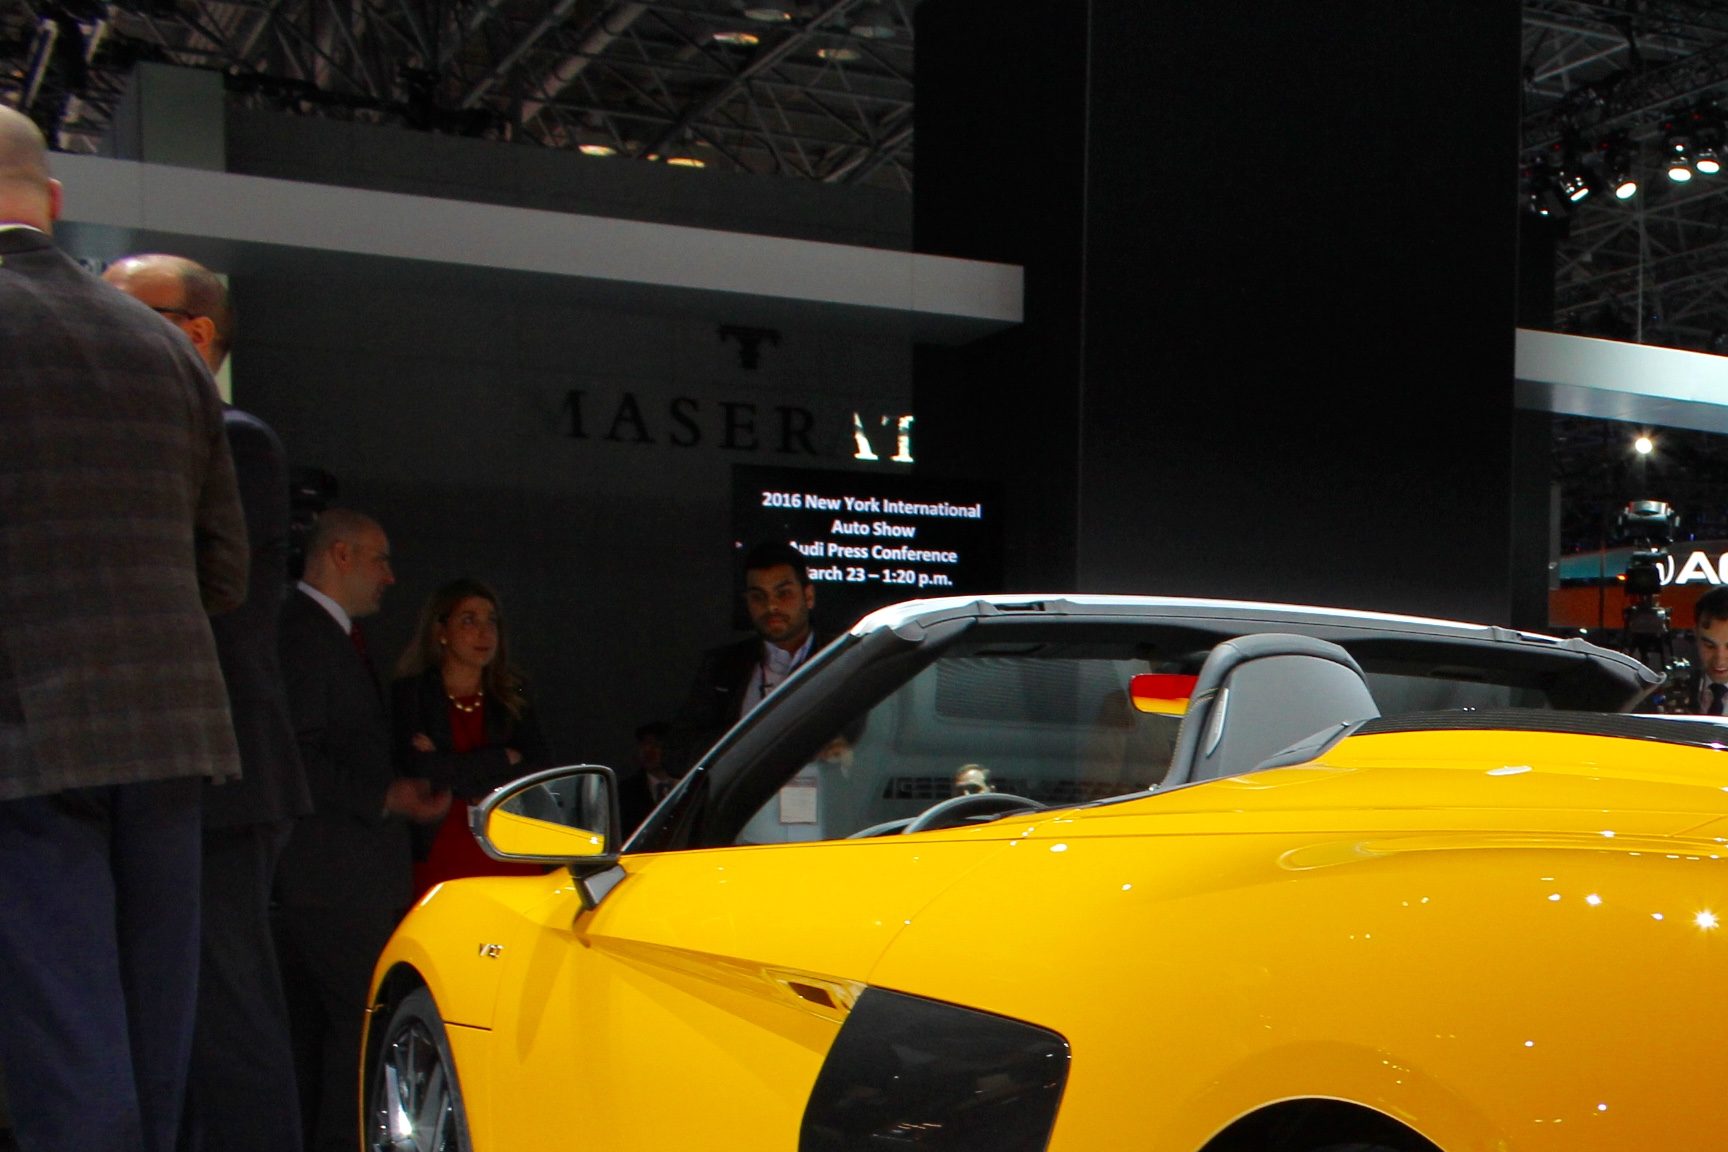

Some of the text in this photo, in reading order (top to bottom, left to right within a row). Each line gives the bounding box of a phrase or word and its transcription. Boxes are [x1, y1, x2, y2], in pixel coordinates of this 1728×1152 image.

[761, 491, 982, 519] 2016 New York International
[830, 519, 916, 538] Auto Show
[827, 543, 869, 559] Press
[871, 545, 958, 563] Conference
[805, 566, 843, 582] arch
[846, 567, 866, 582] 23
[882, 569, 916, 584] 1:20
[918, 573, 953, 588] p.m.
